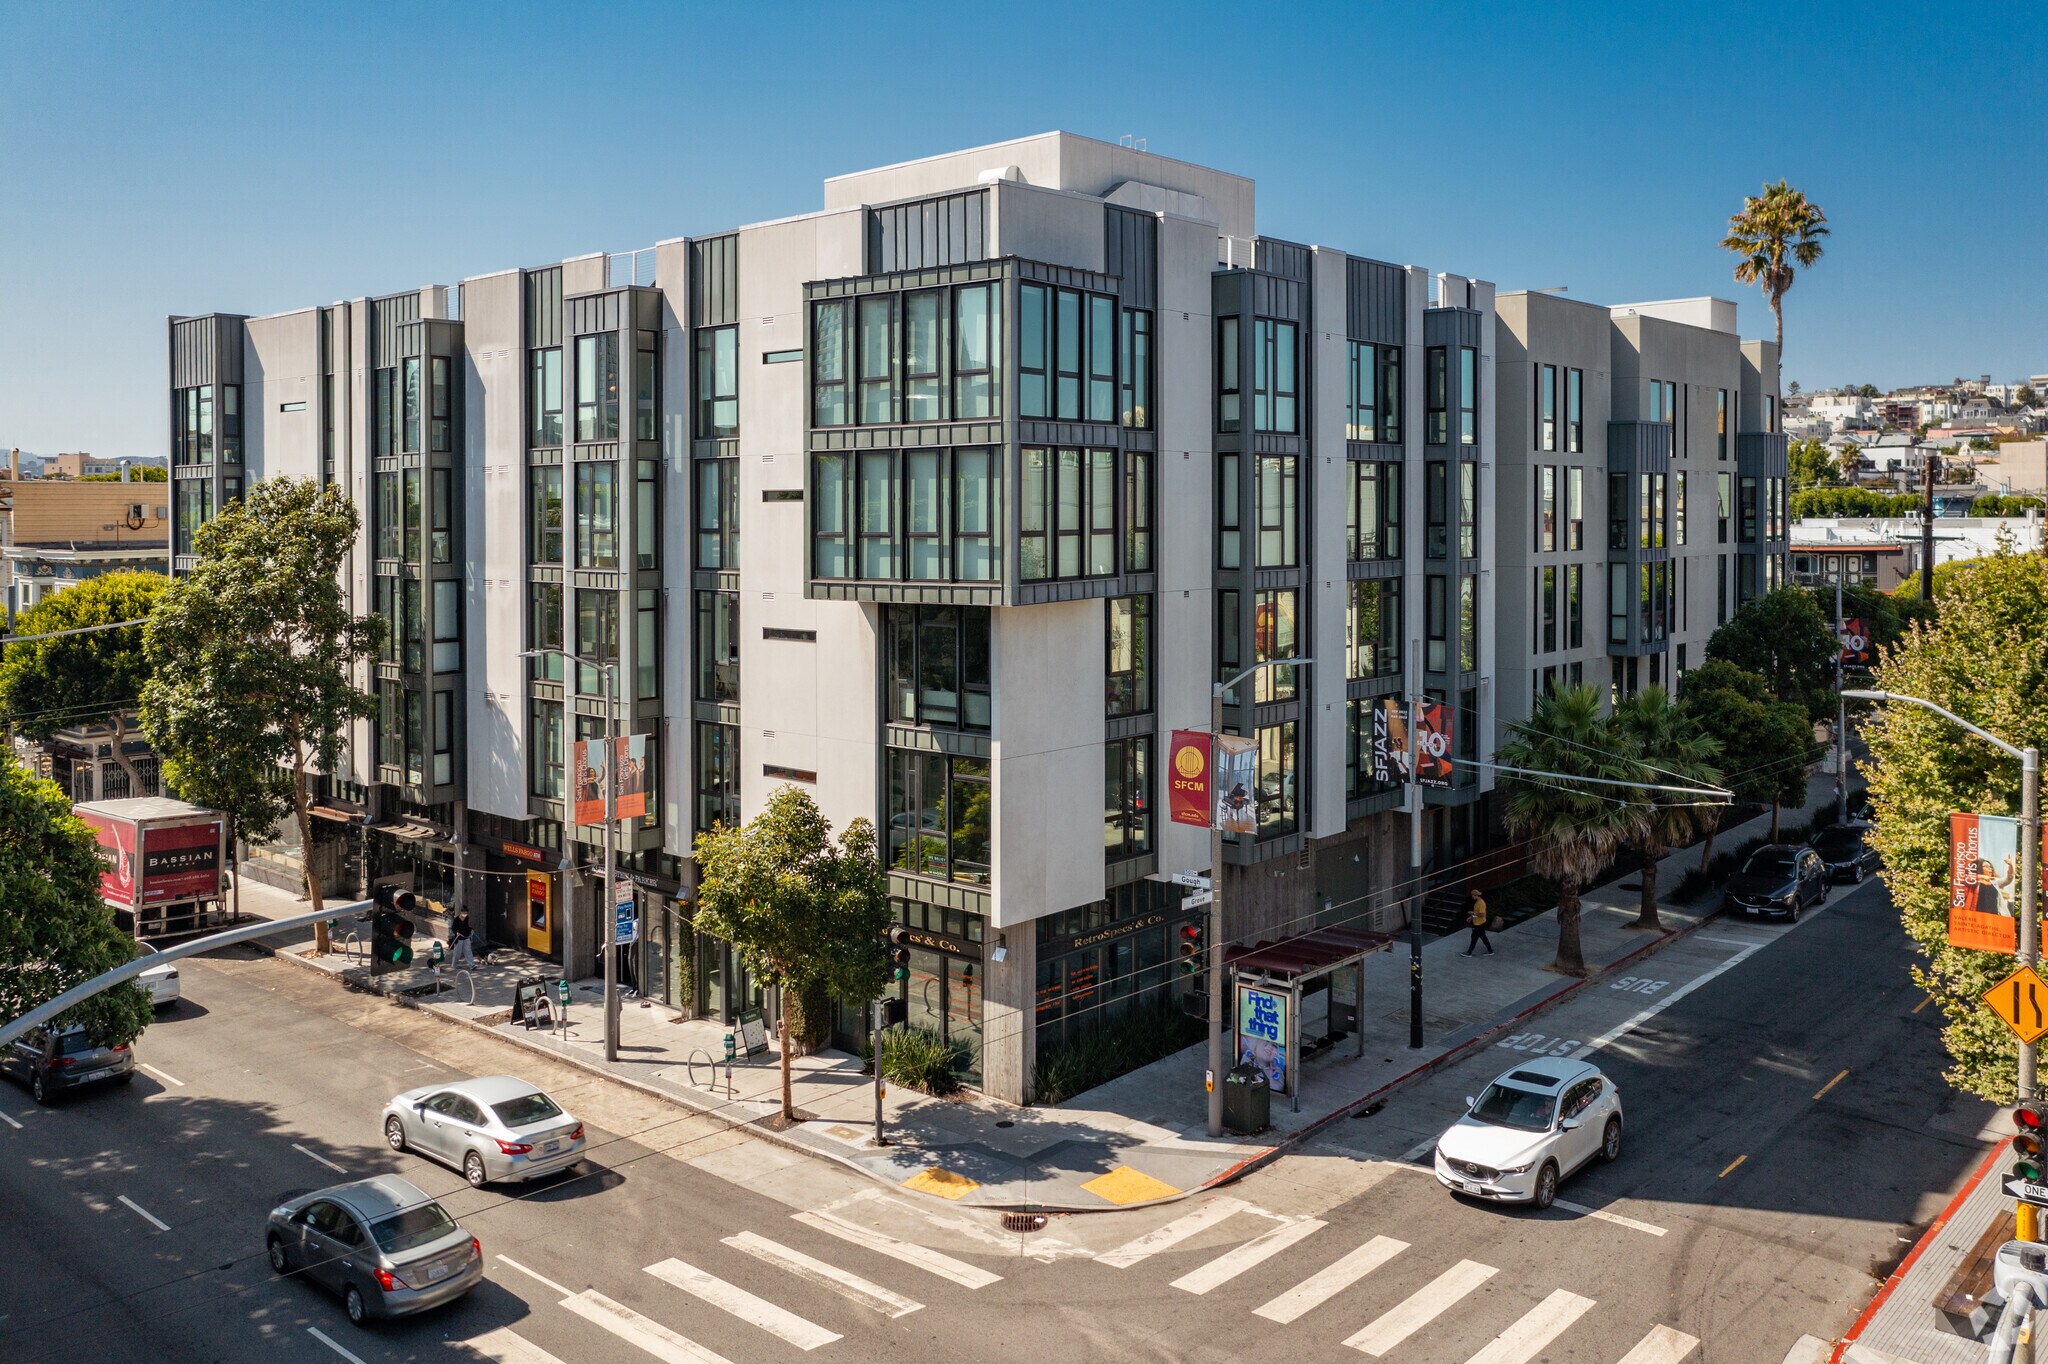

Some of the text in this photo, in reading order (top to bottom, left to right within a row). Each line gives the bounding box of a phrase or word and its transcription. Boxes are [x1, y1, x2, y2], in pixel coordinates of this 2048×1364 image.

[1374, 708, 1389, 782] SFJAZZ
[1418, 730, 1446, 758] 10
[1174, 780, 1204, 791] SFCM
[149, 852, 213, 867] BASSIAN
[503, 844, 518, 853] WELLS
[518, 848, 534, 857] FARGO
[1965, 827, 1978, 885] Girls Chorus
[1181, 876, 1200, 886] Gough
[1953, 841, 1966, 908] San Francisco
[1191, 896, 1205, 905] Grove
[1135, 920, 1145, 929] &
[1147, 915, 1164, 925] Co.
[924, 936, 960, 953] & Co.
[1610, 976, 1670, 995] BUS
[1248, 991, 1274, 1010] Find
[1254, 1006, 1279, 1025] that
[1248, 1018, 1279, 1041] thing
[1496, 1032, 1581, 1056] STOP
[2024, 1184, 2046, 1198] ONE
